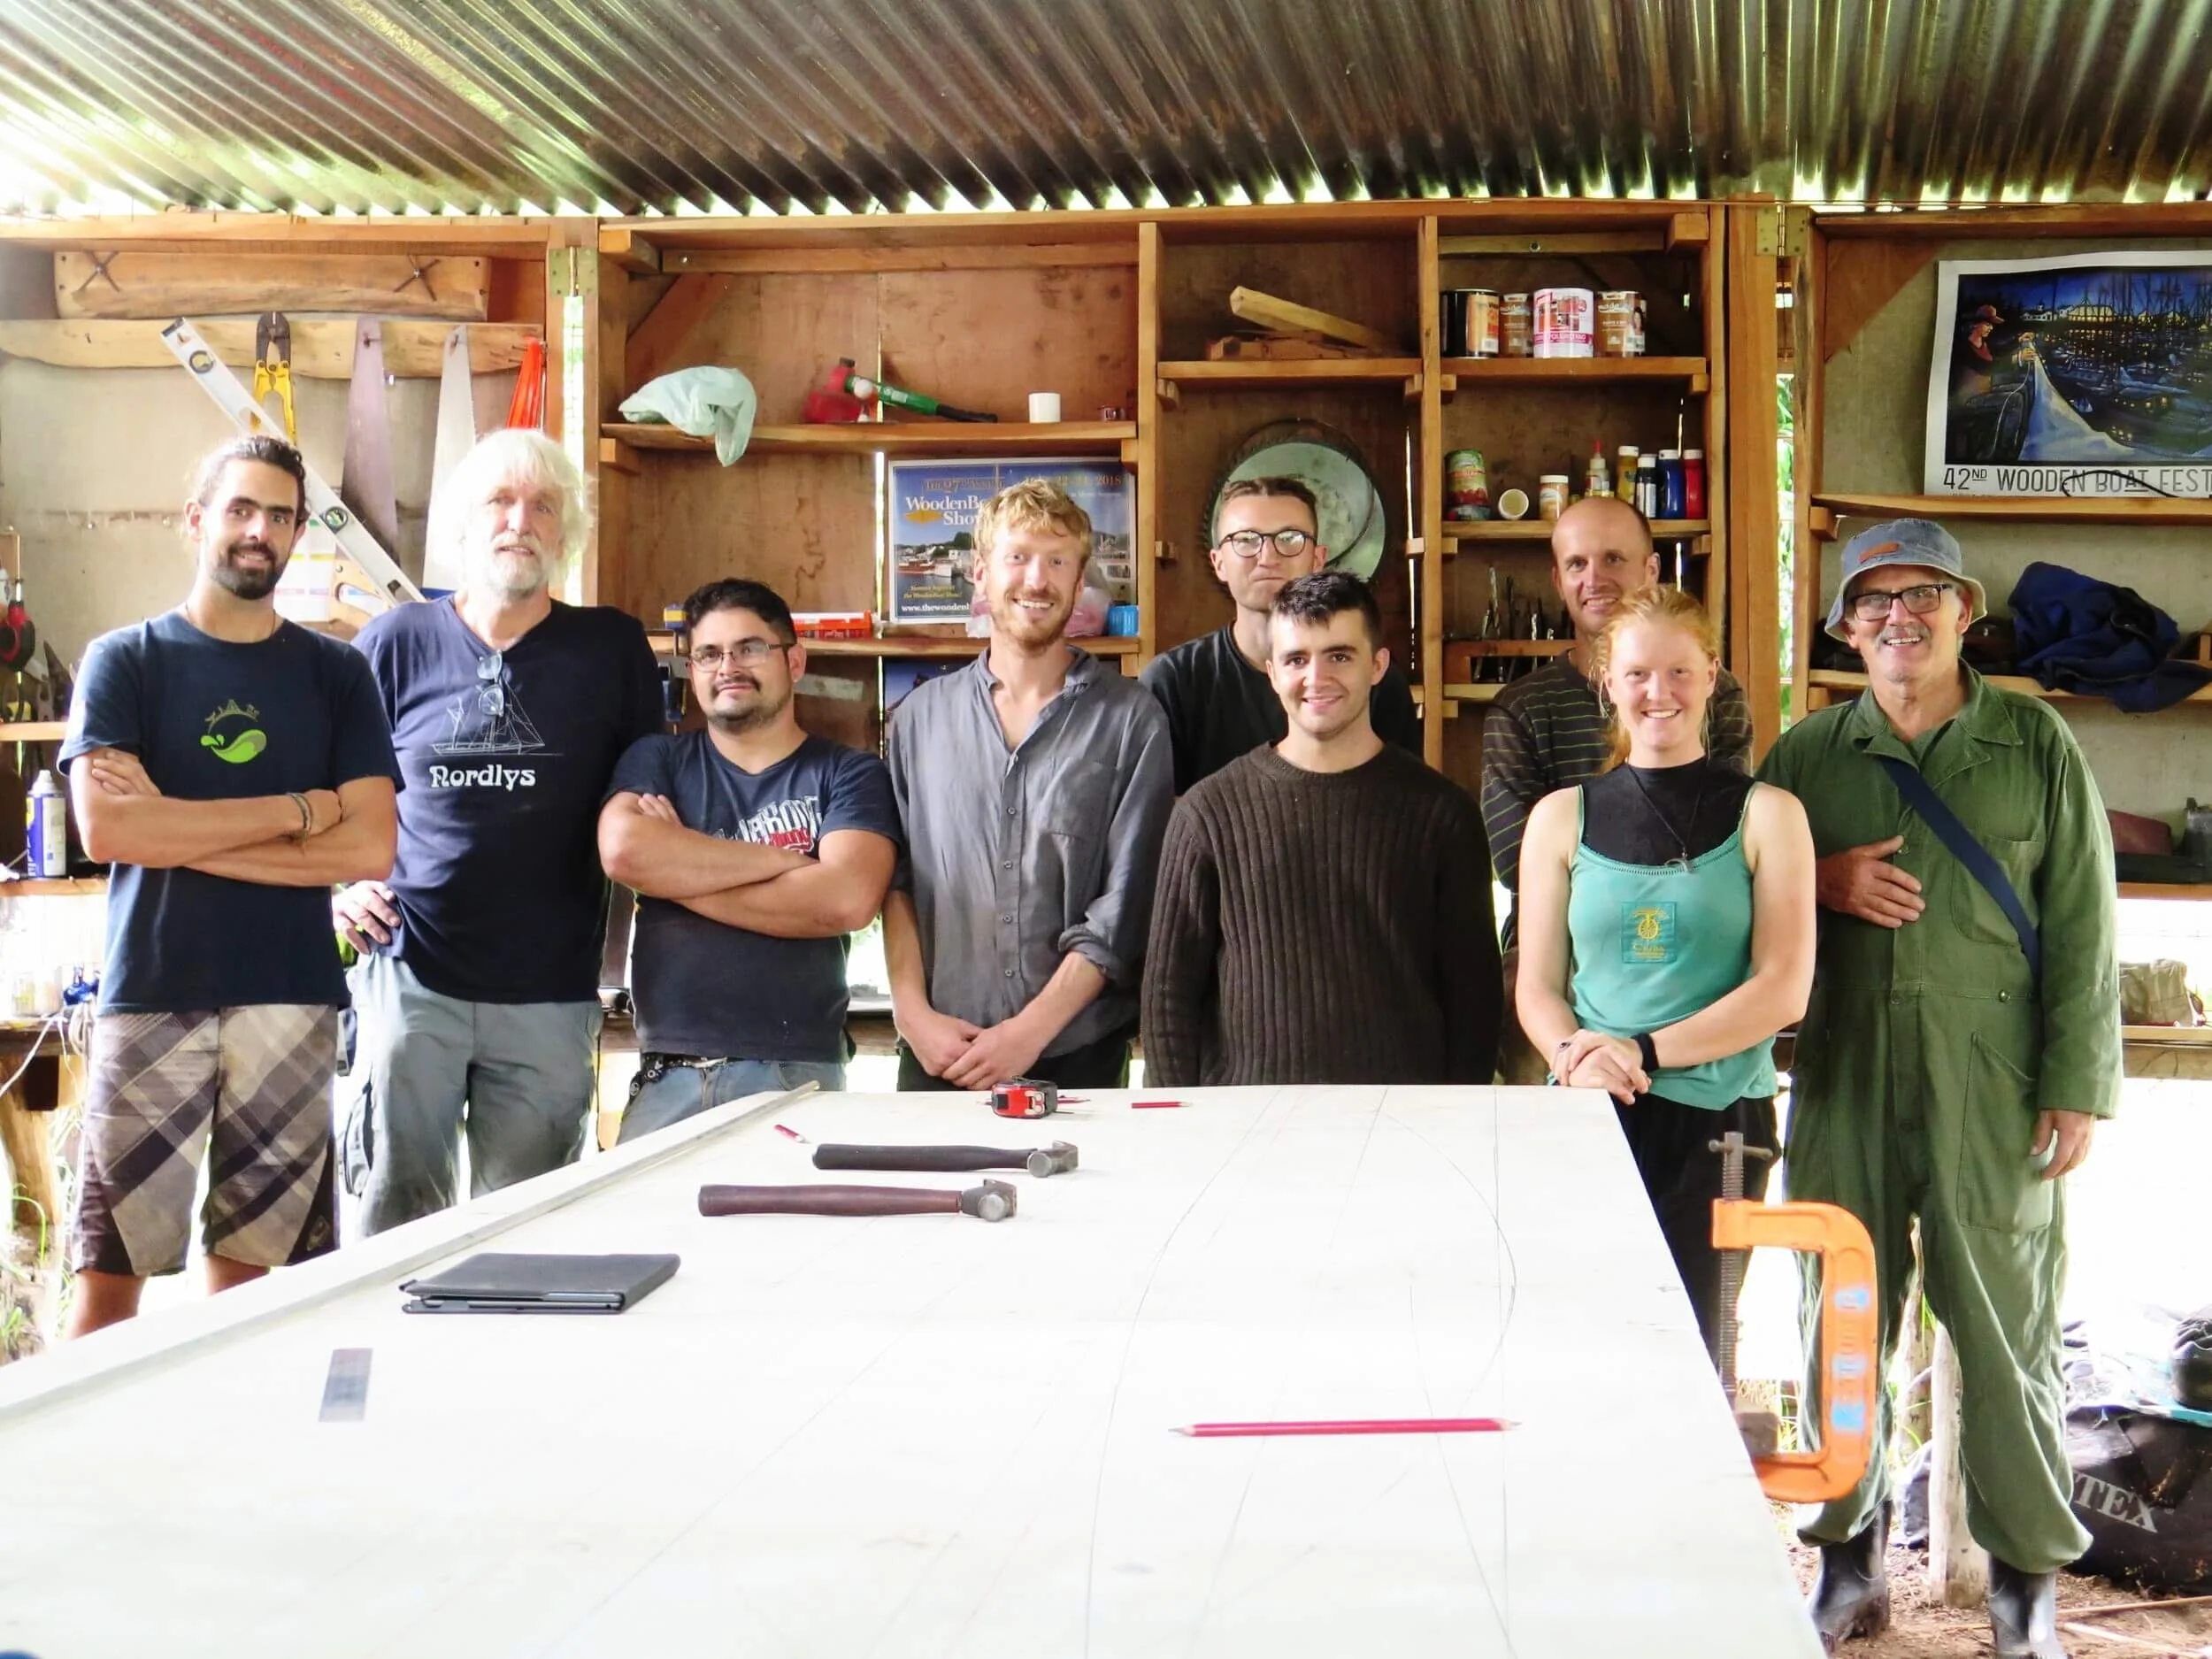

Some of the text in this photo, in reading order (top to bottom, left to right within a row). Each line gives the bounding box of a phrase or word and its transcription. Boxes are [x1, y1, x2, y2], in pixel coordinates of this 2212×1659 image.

[1997, 469, 2085, 493] WOODEN
[2095, 470, 2149, 493] BOAT
[905, 495, 986, 511] WoodenB
[901, 603, 970, 611] www.thewooden
[429, 764, 536, 792] Nordlys
[2072, 1470, 2158, 1533] TEX
